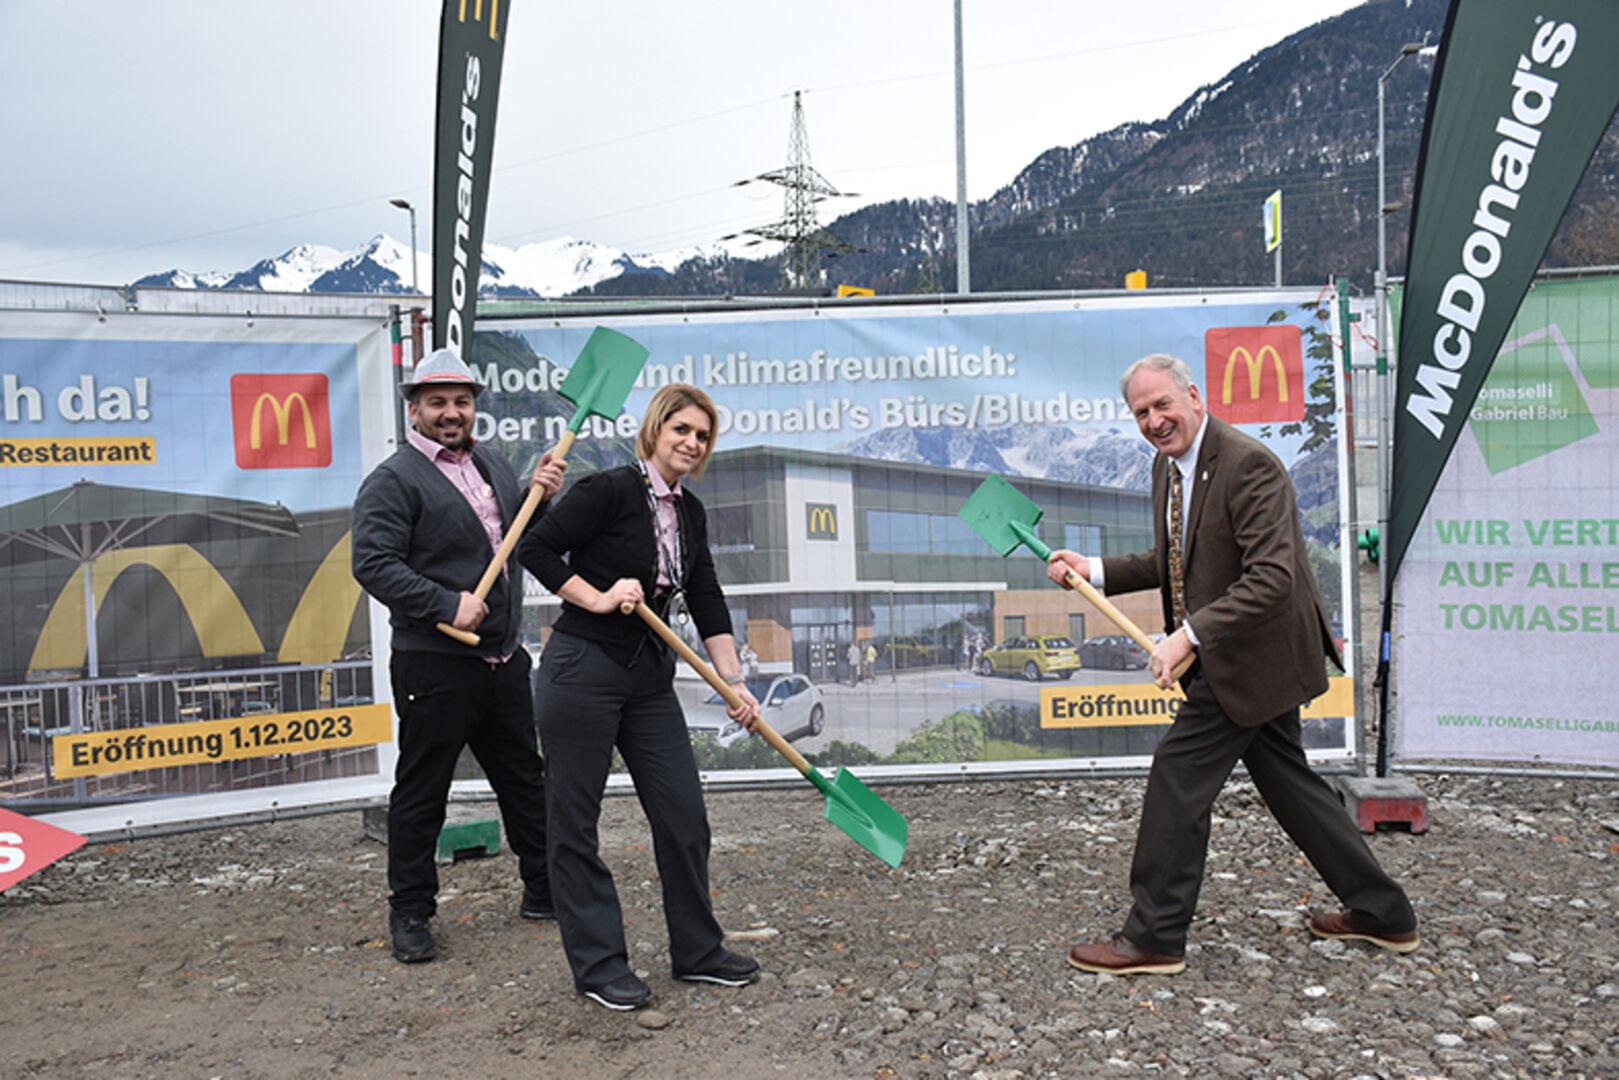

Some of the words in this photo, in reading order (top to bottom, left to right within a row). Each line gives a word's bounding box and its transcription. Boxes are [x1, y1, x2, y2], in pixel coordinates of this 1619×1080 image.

[446, 52, 480, 355] Donald's
[1406, 18, 1577, 440] McDonald's
[469, 358, 570, 393] Mode
[703, 345, 1016, 385] klimafreundlich:
[58, 374, 150, 421] da!
[1479, 382, 1553, 400] omaselli
[472, 411, 537, 442] Der
[544, 412, 638, 441] neue
[1471, 404, 1534, 421] Gabriel
[1538, 404, 1568, 420] Bau
[0, 441, 151, 464] Restaurant
[1435, 519, 1511, 545] WIR
[1524, 519, 1619, 545] VERT
[1439, 561, 1514, 587] AUF
[1527, 562, 1619, 589] ALLE
[1439, 604, 1619, 633] TOMASEL
[71, 731, 222, 767] Eröffnung
[230, 715, 353, 749] 1.12.2023
